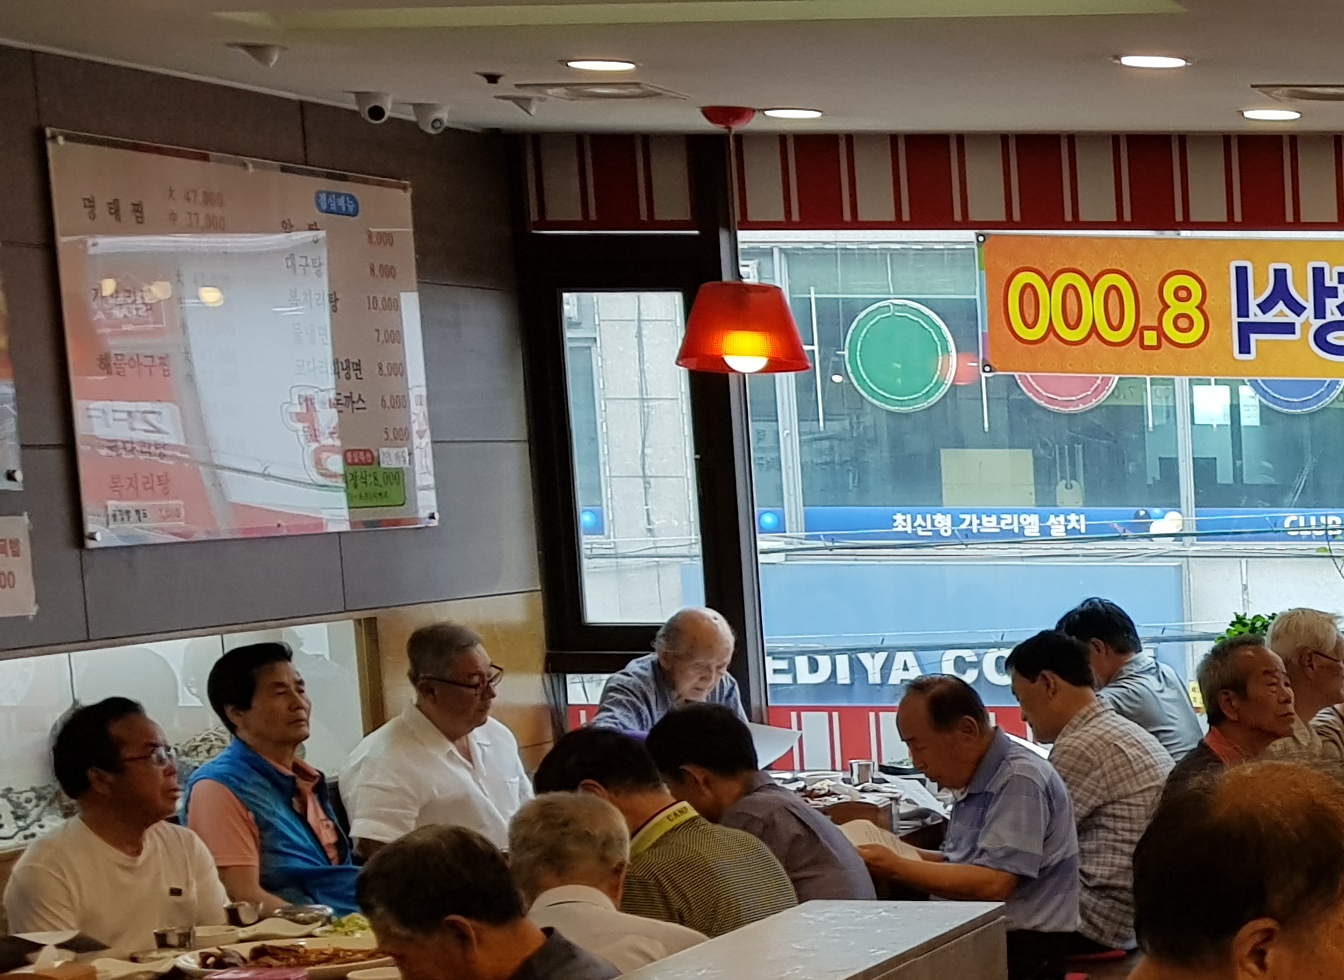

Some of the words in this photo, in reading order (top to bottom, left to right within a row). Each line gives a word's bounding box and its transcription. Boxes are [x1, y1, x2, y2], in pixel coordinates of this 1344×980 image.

[891, 512, 954, 537] 최신형
[957, 513, 1041, 537] 가브리엘
[1045, 512, 1087, 538] 설치
[1283, 514, 1342, 537] CLUB
[766, 650, 922, 687] EDIYA
